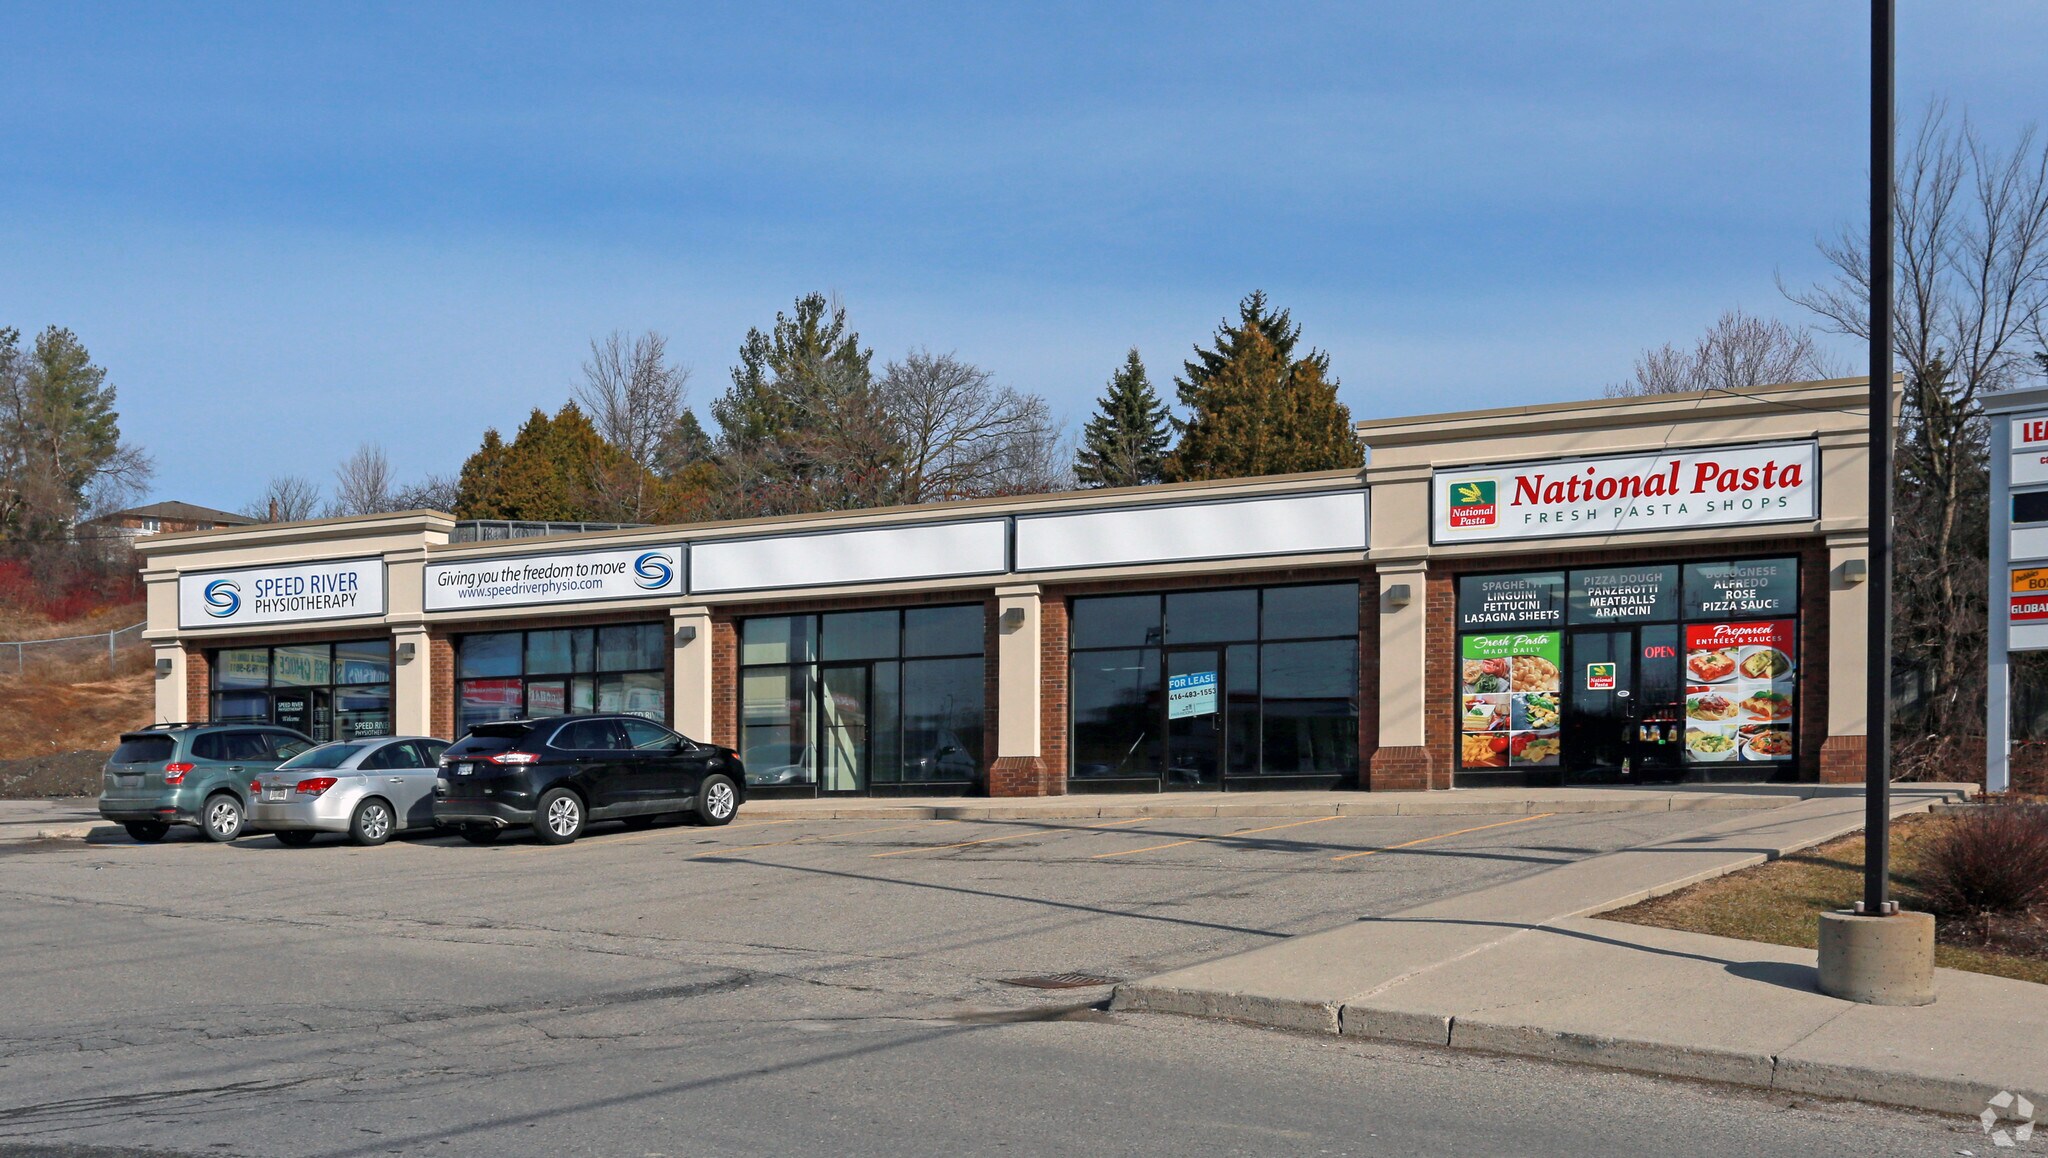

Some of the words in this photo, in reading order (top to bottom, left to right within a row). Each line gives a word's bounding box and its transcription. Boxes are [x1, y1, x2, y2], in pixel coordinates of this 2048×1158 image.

[1510, 460, 1681, 506] National
[1690, 460, 1803, 494] Pasta
[1452, 506, 1493, 517] National
[1524, 509, 1597, 524] FRESH
[1614, 503, 1688, 518] PASTA
[1706, 496, 1787, 512] SHOPS
[1460, 517, 1486, 525] Pasta
[438, 571, 476, 588] Giving
[477, 571, 498, 587] you
[501, 567, 520, 582] the
[522, 562, 575, 580] freedom
[576, 564, 588, 576] to
[590, 560, 626, 575] move
[1706, 566, 1777, 579] BOLOGNESE
[255, 576, 304, 598] SPEED
[311, 572, 358, 594] RIVER
[1482, 580, 1542, 591] SPAGHETTI
[1584, 576, 1616, 586] PIZZA
[1621, 573, 1662, 584] DOUGH
[1714, 578, 1768, 589] ALFREDO
[2029, 578, 2048, 589] BO
[458, 577, 603, 599] www.speedriverphysio.com
[1588, 584, 1658, 596] PANZEROTTI
[1488, 591, 1536, 601] LINGUINI
[1590, 595, 1656, 606] MEATBALLS
[1726, 590, 1756, 600] ROSE
[255, 593, 357, 614] PHYSIOTHERAPY
[1484, 601, 1540, 612] FETTUCINI
[1703, 602, 1737, 611] PIZZA
[1741, 600, 1779, 610] SAUCE
[1464, 613, 1516, 623] LASAGNA
[1519, 610, 1559, 620] SHEETS
[1595, 606, 1650, 617] ARANCINI
[1713, 624, 1774, 639] Prepared
[1473, 636, 1510, 649] Fresh
[1513, 635, 1550, 647] Pasta
[1645, 646, 1675, 659] OPEN
[1169, 678, 1186, 688] FOR
[1188, 674, 1216, 685] LEASE
[1169, 688, 1216, 701] 416-483-1553
[355, 722, 374, 730] SPEED
